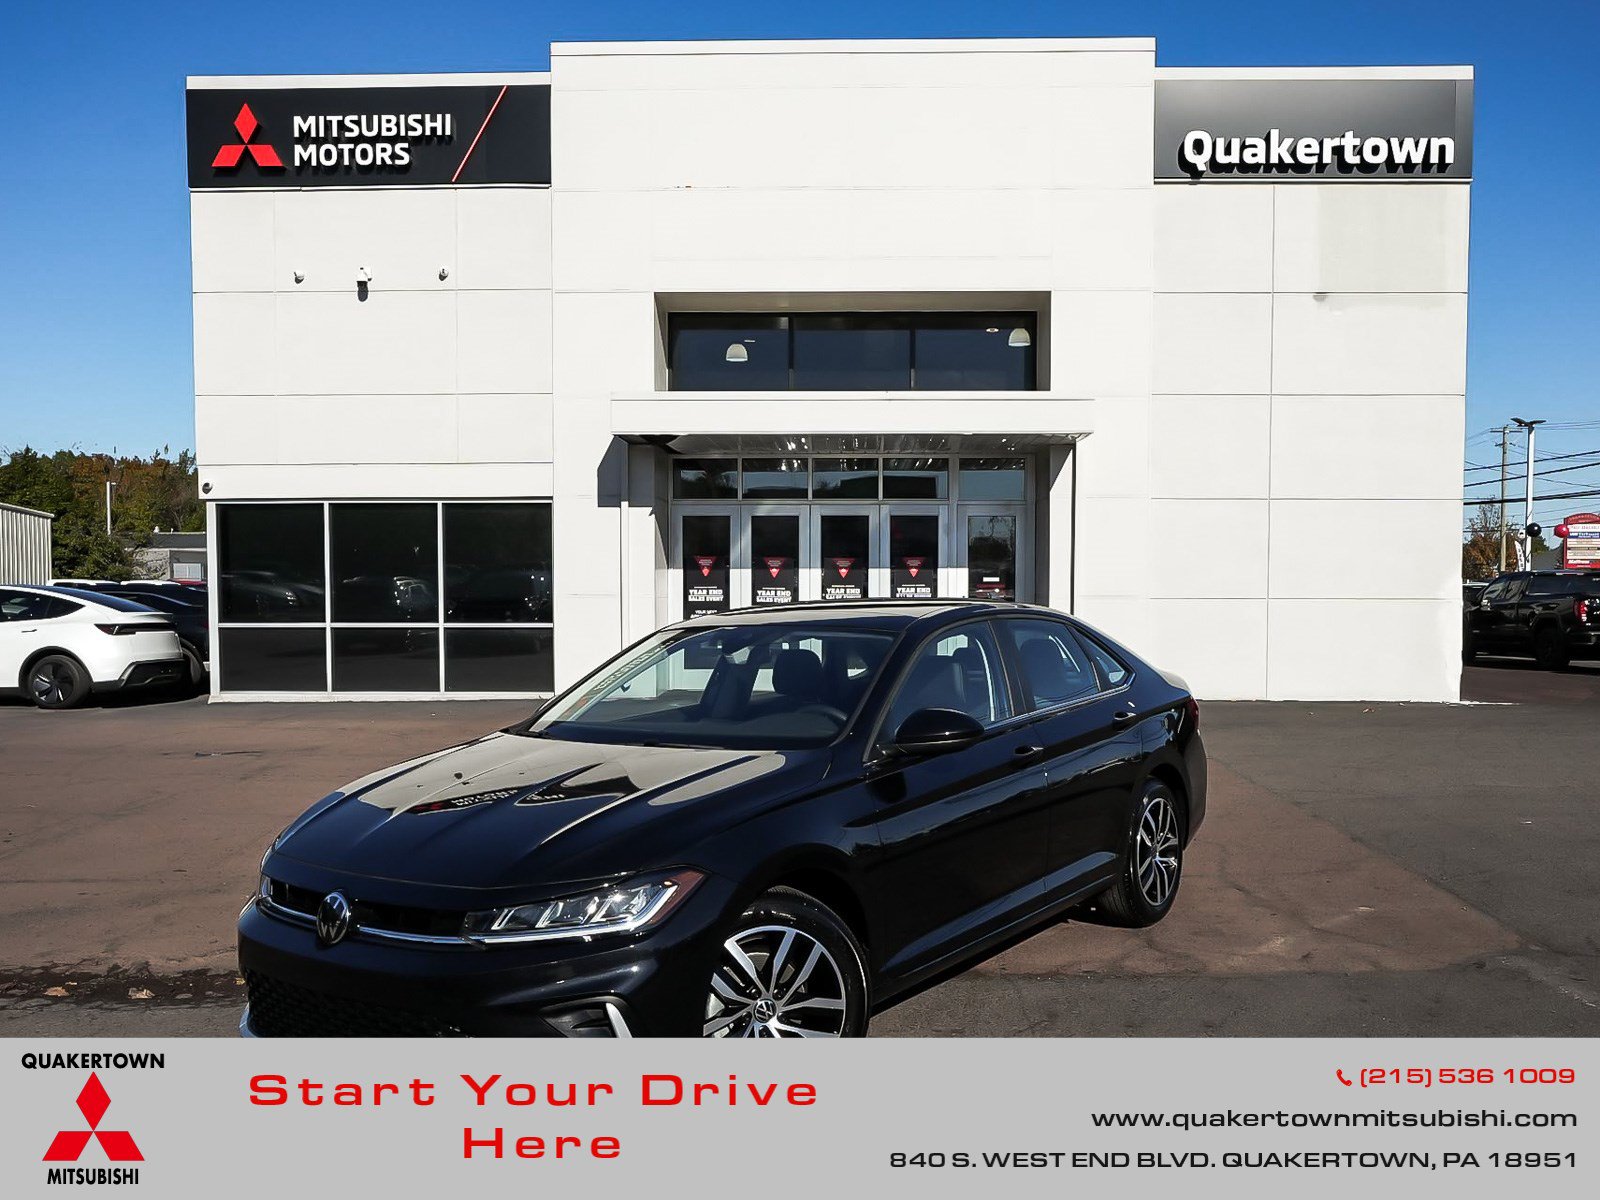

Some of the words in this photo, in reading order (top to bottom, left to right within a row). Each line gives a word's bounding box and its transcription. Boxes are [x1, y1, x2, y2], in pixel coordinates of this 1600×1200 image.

[293, 113, 452, 138] MITSUBISHI
[293, 142, 411, 167] MOTORS
[1183, 128, 1455, 172] Quakertown
